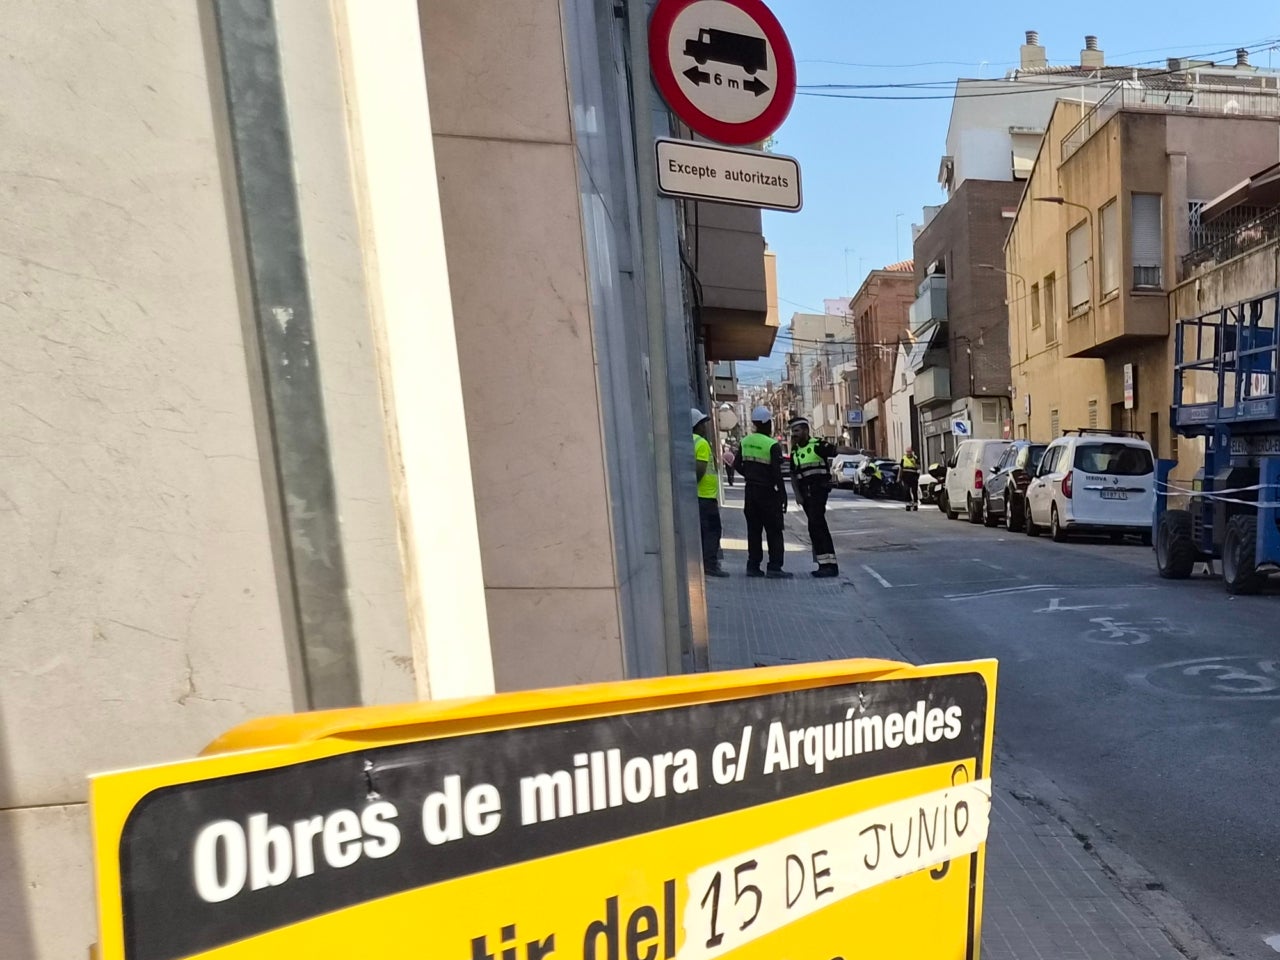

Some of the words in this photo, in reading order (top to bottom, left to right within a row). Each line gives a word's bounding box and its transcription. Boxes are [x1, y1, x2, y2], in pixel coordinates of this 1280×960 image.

[713, 73, 723, 86] 6
[728, 78, 739, 89] m
[668, 159, 717, 179] Excepte
[724, 169, 789, 188] autoritzats
[193, 800, 402, 904] Obres
[422, 775, 502, 846] de
[520, 747, 698, 827] millora
[711, 725, 752, 785] c/
[763, 700, 963, 776] Arquímedes
[700, 859, 763, 949] 15
[785, 849, 835, 909] DE
